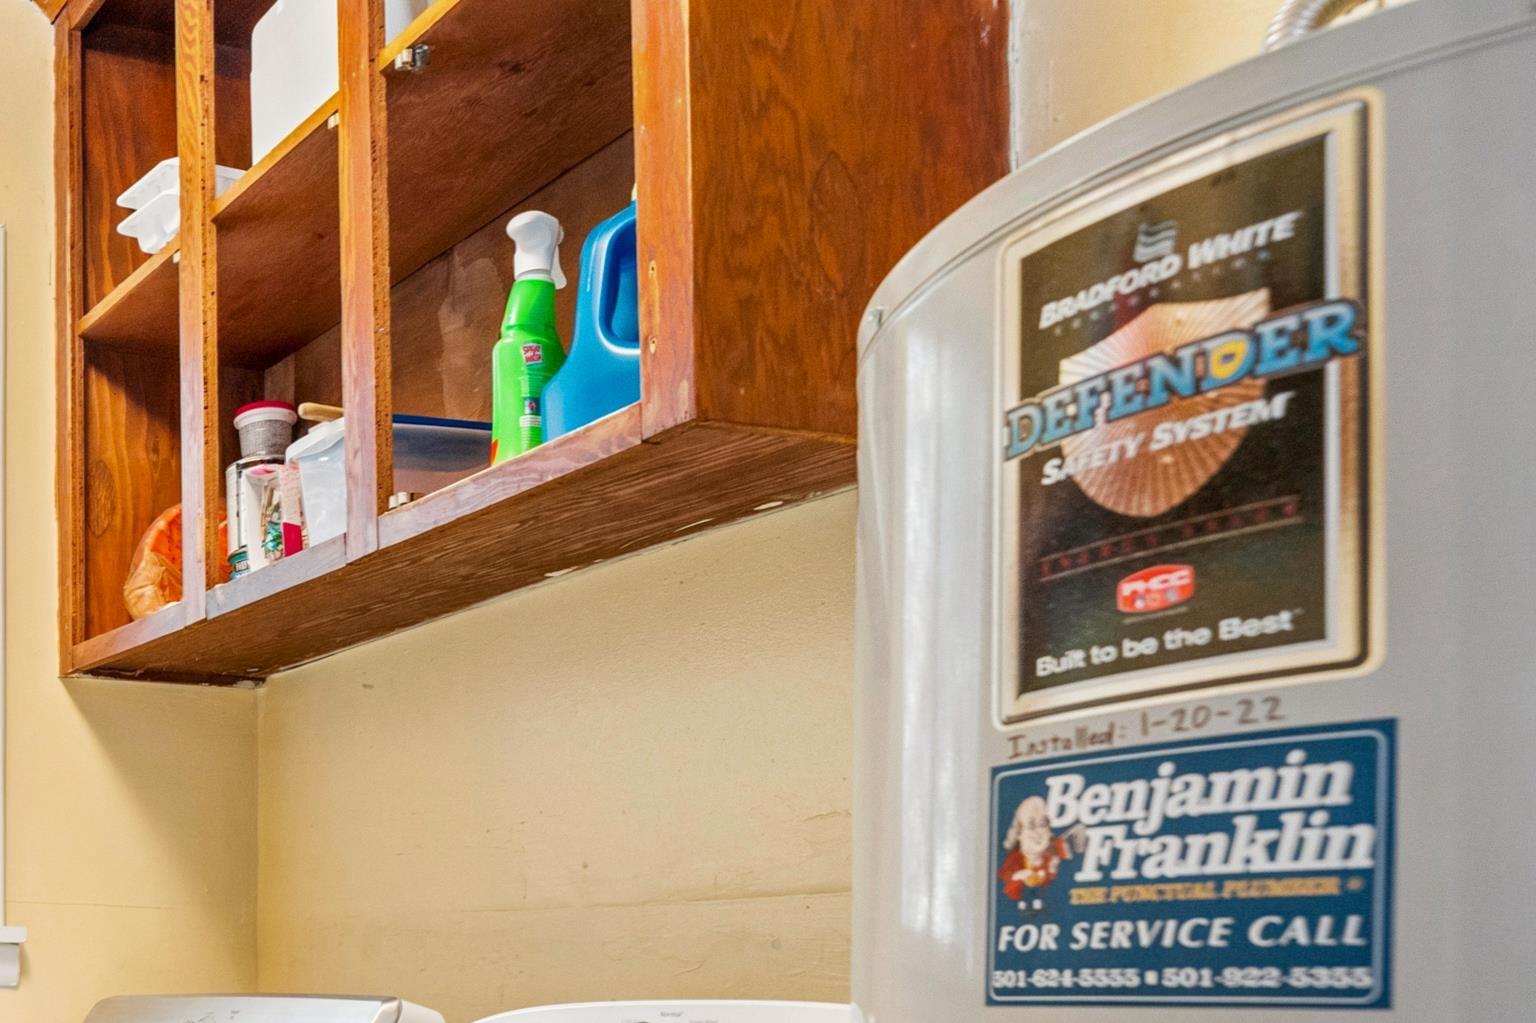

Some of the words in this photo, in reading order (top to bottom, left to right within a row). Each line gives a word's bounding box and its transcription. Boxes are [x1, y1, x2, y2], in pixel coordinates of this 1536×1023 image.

[1039, 254, 1183, 330] BRADFORD
[1187, 210, 1302, 270] WHITE
[1004, 301, 1360, 460] DEFENDER
[1041, 431, 1146, 486] SAFETY
[1150, 390, 1297, 452] SYSTEM
[1036, 649, 1086, 677] Built
[1089, 645, 1119, 665] to
[1122, 637, 1159, 658] be
[1163, 627, 1212, 650] the
[1218, 610, 1294, 641] Best
[1140, 696, 1286, 737] 1-20-22
[1045, 748, 1354, 835] Benjamin
[1073, 810, 1376, 883] Franklin
[997, 924, 1061, 952] FOR
[1069, 917, 1235, 950] SERVICE
[1247, 914, 1366, 947] CALL
